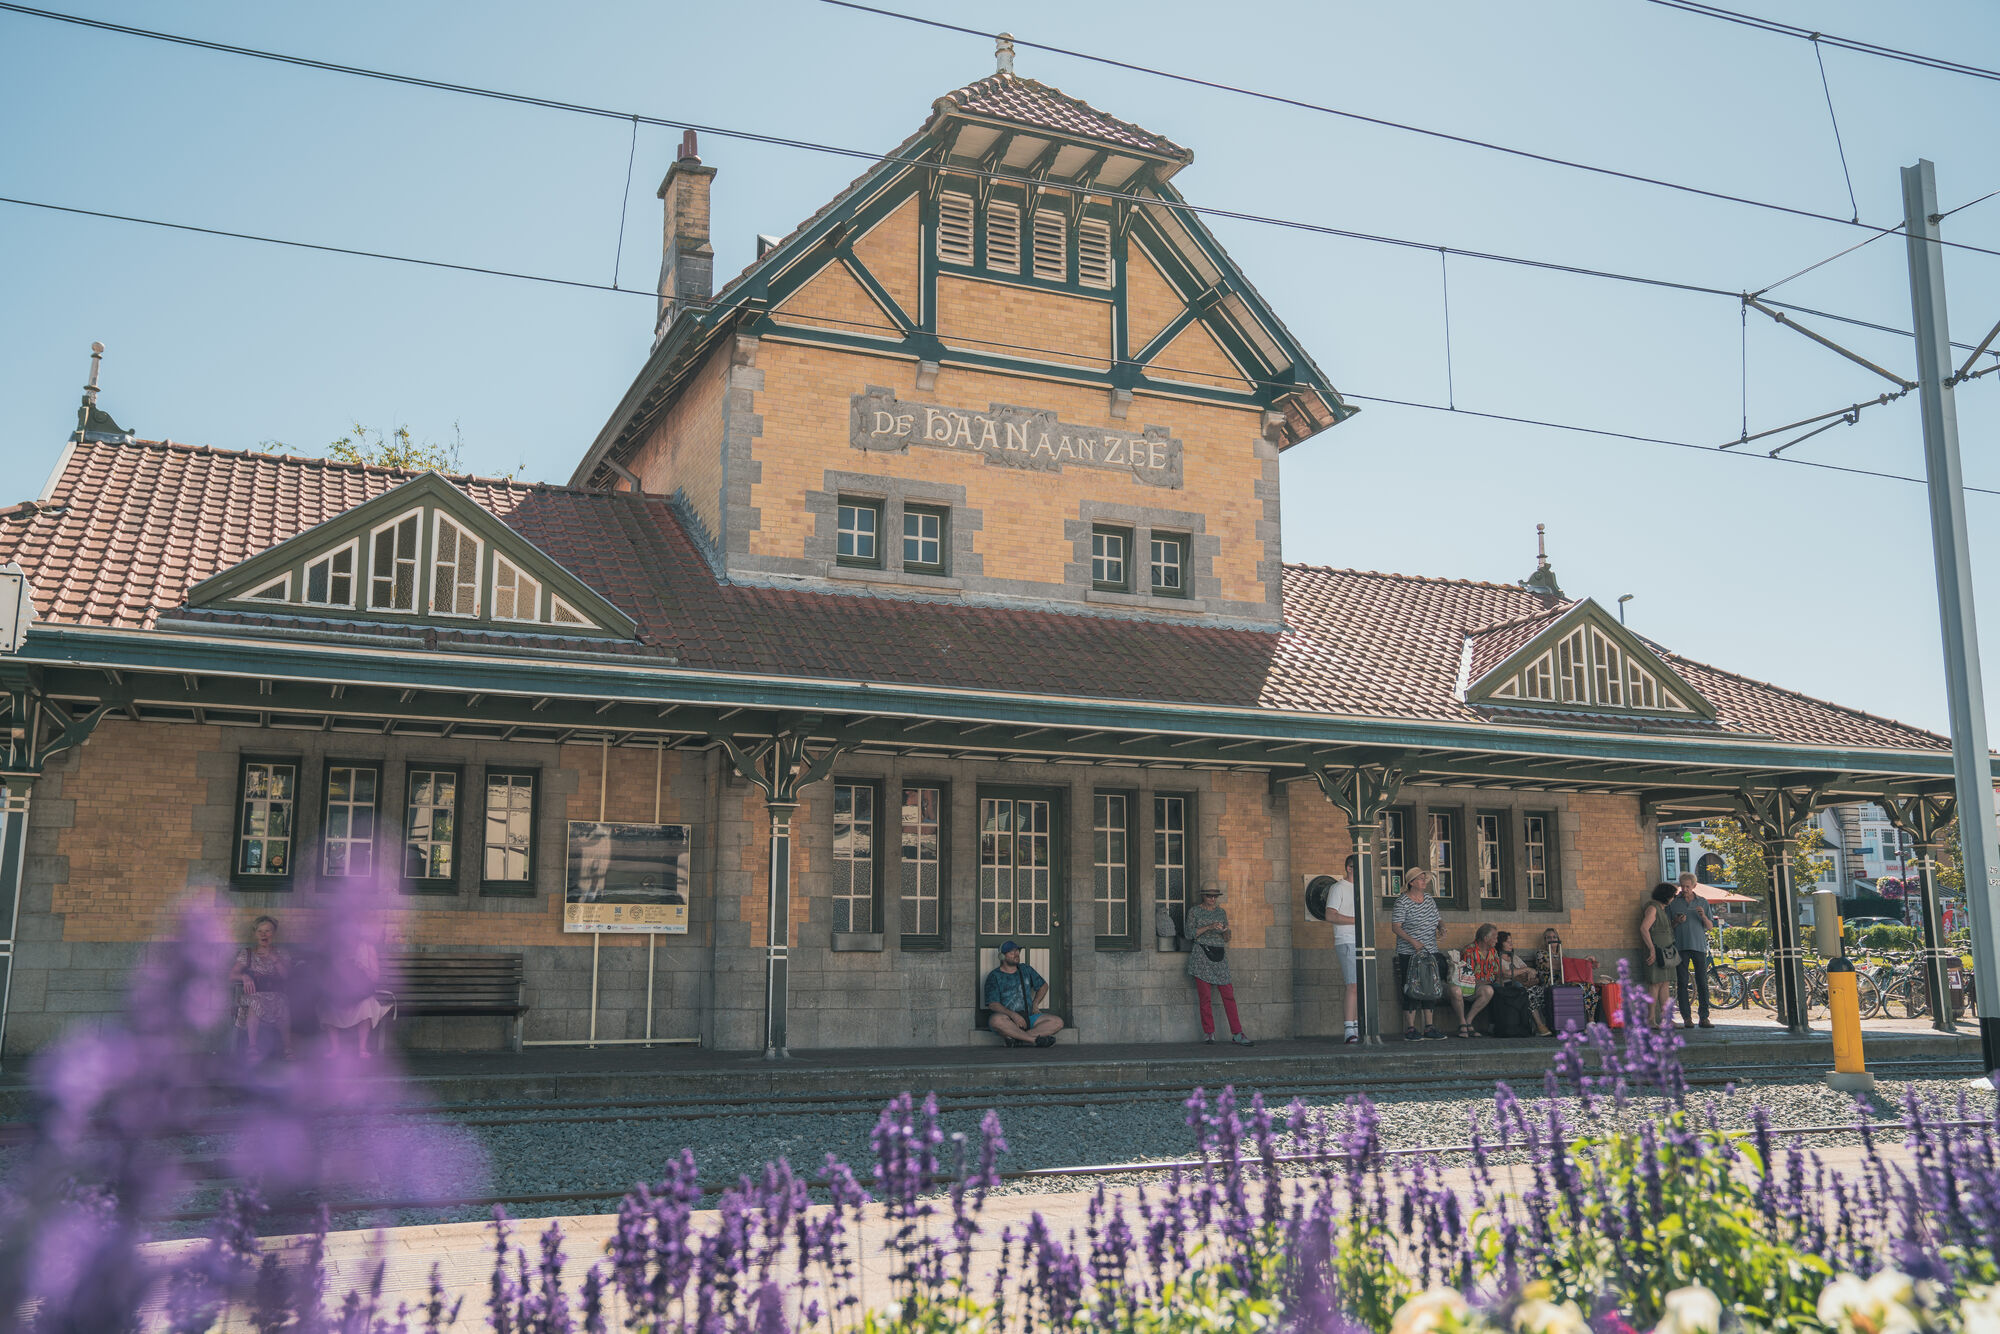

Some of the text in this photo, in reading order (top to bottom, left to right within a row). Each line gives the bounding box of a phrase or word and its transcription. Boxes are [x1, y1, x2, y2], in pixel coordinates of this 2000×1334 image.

[871, 408, 1168, 469] DE HAAN AAN ZEE
